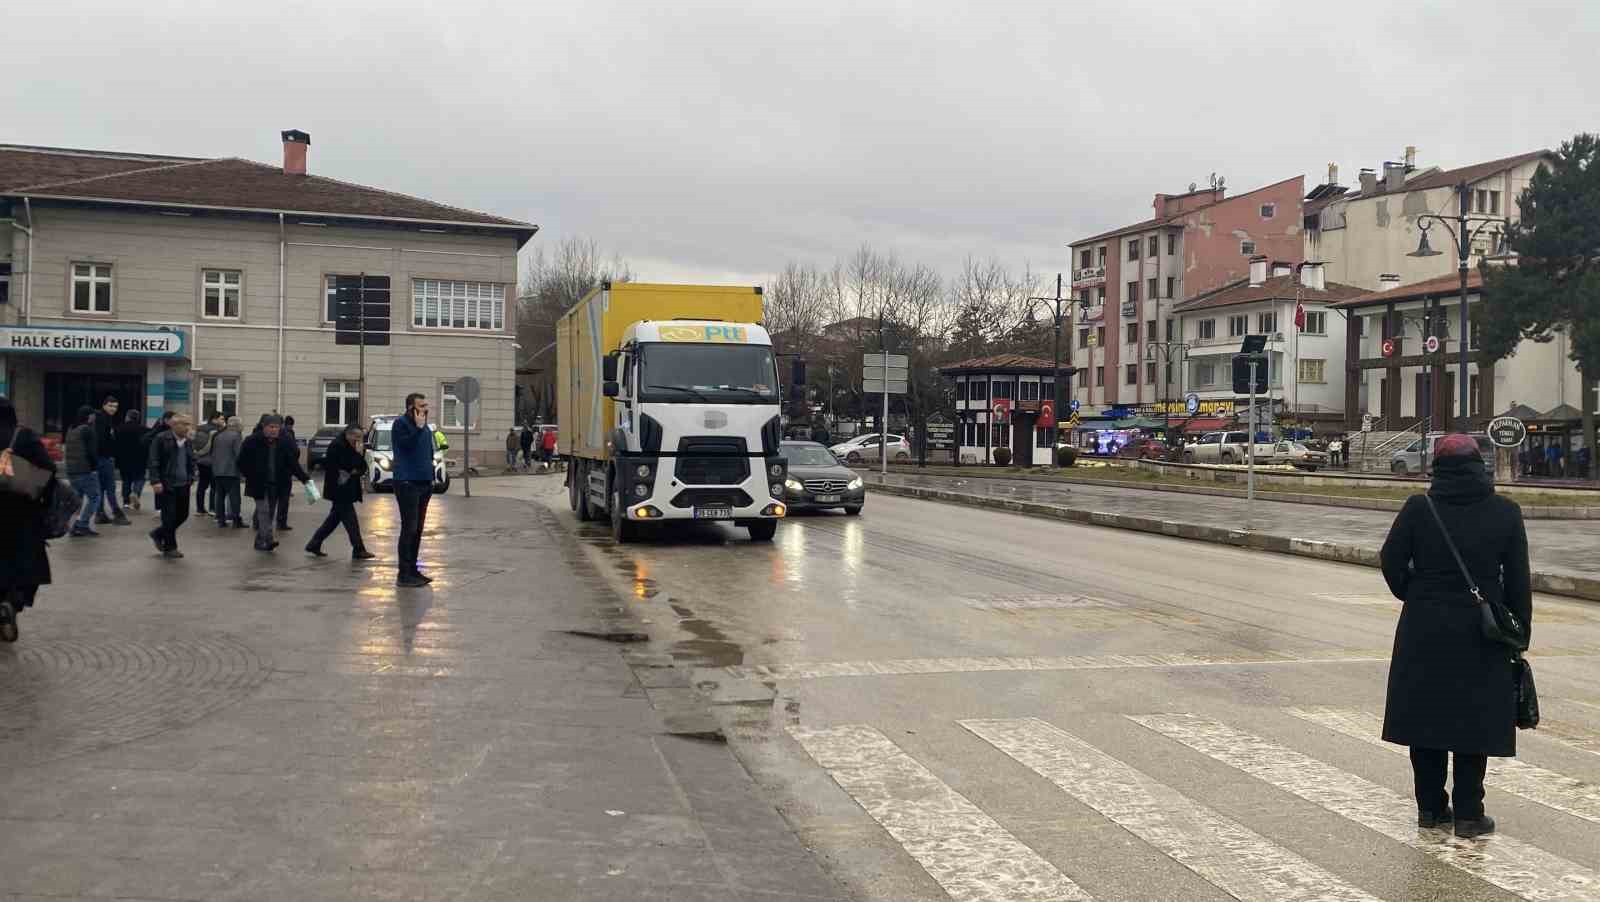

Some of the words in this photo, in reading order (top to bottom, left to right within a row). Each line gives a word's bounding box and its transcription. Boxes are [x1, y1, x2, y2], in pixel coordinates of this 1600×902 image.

[11, 336, 50, 349] HALK
[53, 335, 106, 349] EĞİTİMİ
[110, 338, 169, 351] MERKEZİ
